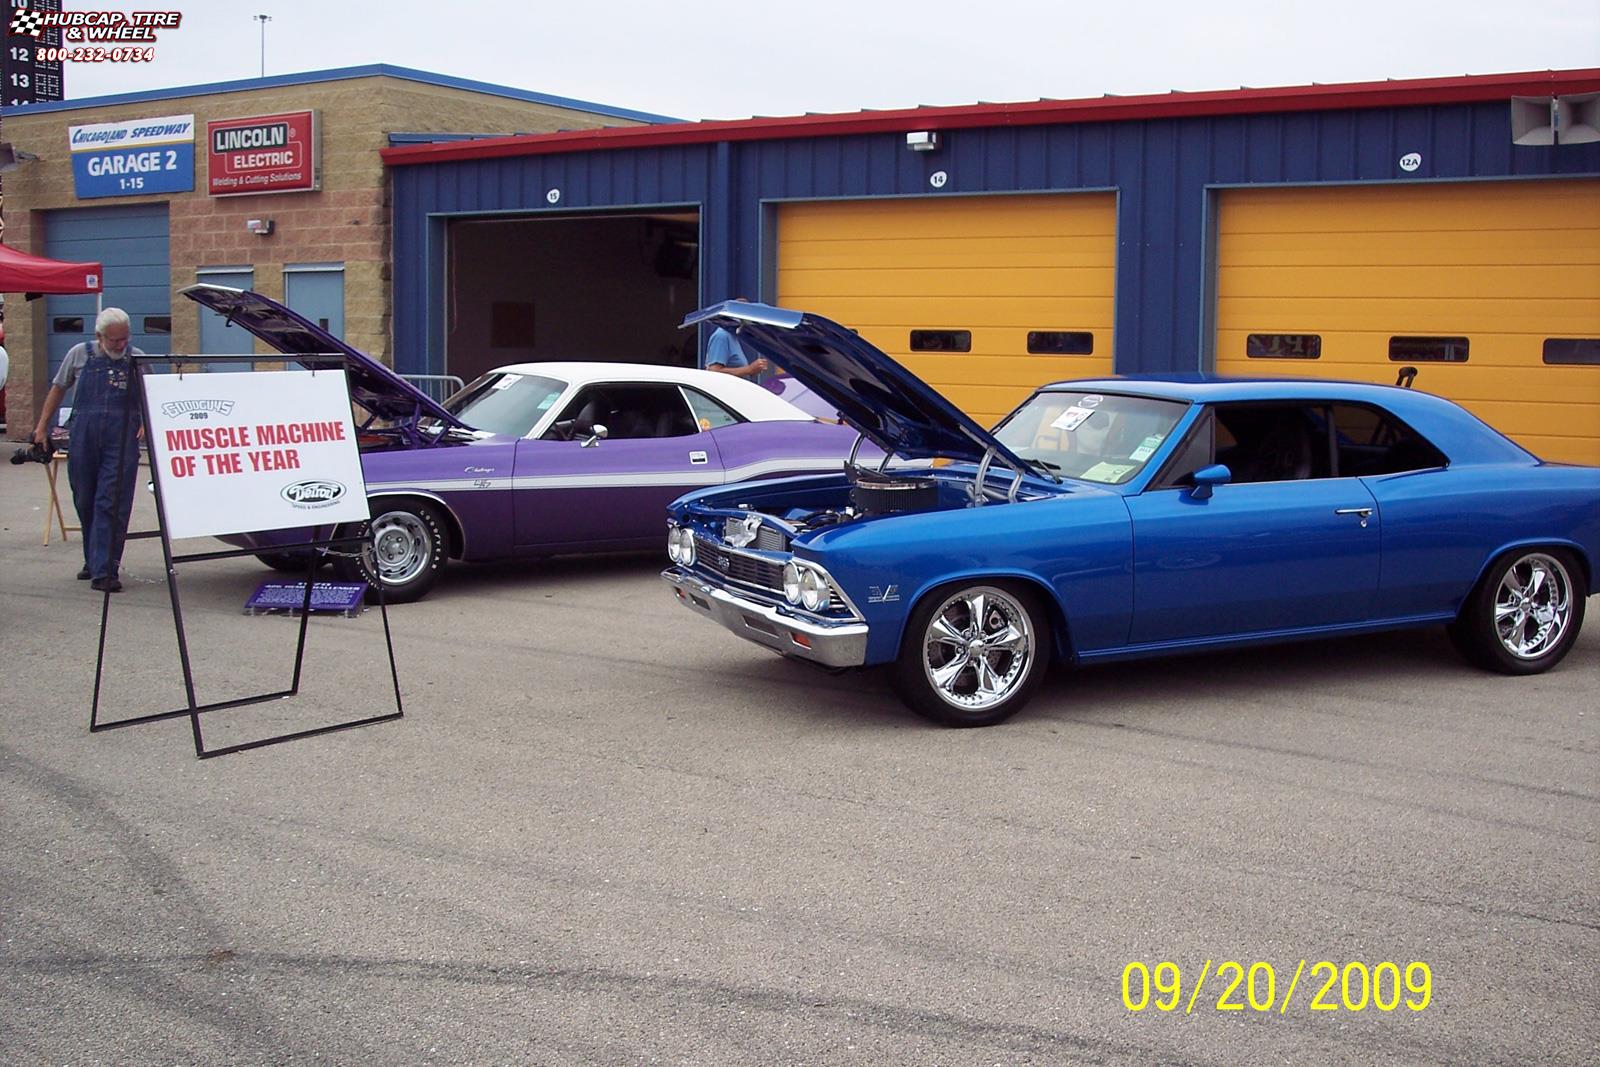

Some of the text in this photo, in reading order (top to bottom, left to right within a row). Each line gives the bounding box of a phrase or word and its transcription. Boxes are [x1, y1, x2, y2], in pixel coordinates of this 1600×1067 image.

[10, 47, 29, 62] 12
[10, 73, 30, 88] 13
[131, 122, 191, 138] SPEEDWAY
[216, 126, 284, 150] LINCOLN
[88, 150, 177, 176] GARAGE 2
[233, 151, 293, 169] ELECTRIC
[1402, 158, 1418, 166] 12A
[120, 177, 144, 190] 1-15
[213, 172, 302, 187] Welding & Cutting Solutions
[934, 175, 943, 184] 14
[161, 400, 235, 418] GOODGUYS
[190, 412, 208, 420] 2009
[166, 421, 346, 451] MUSCLE MACHINE
[171, 449, 300, 478] OF THE YEAR
